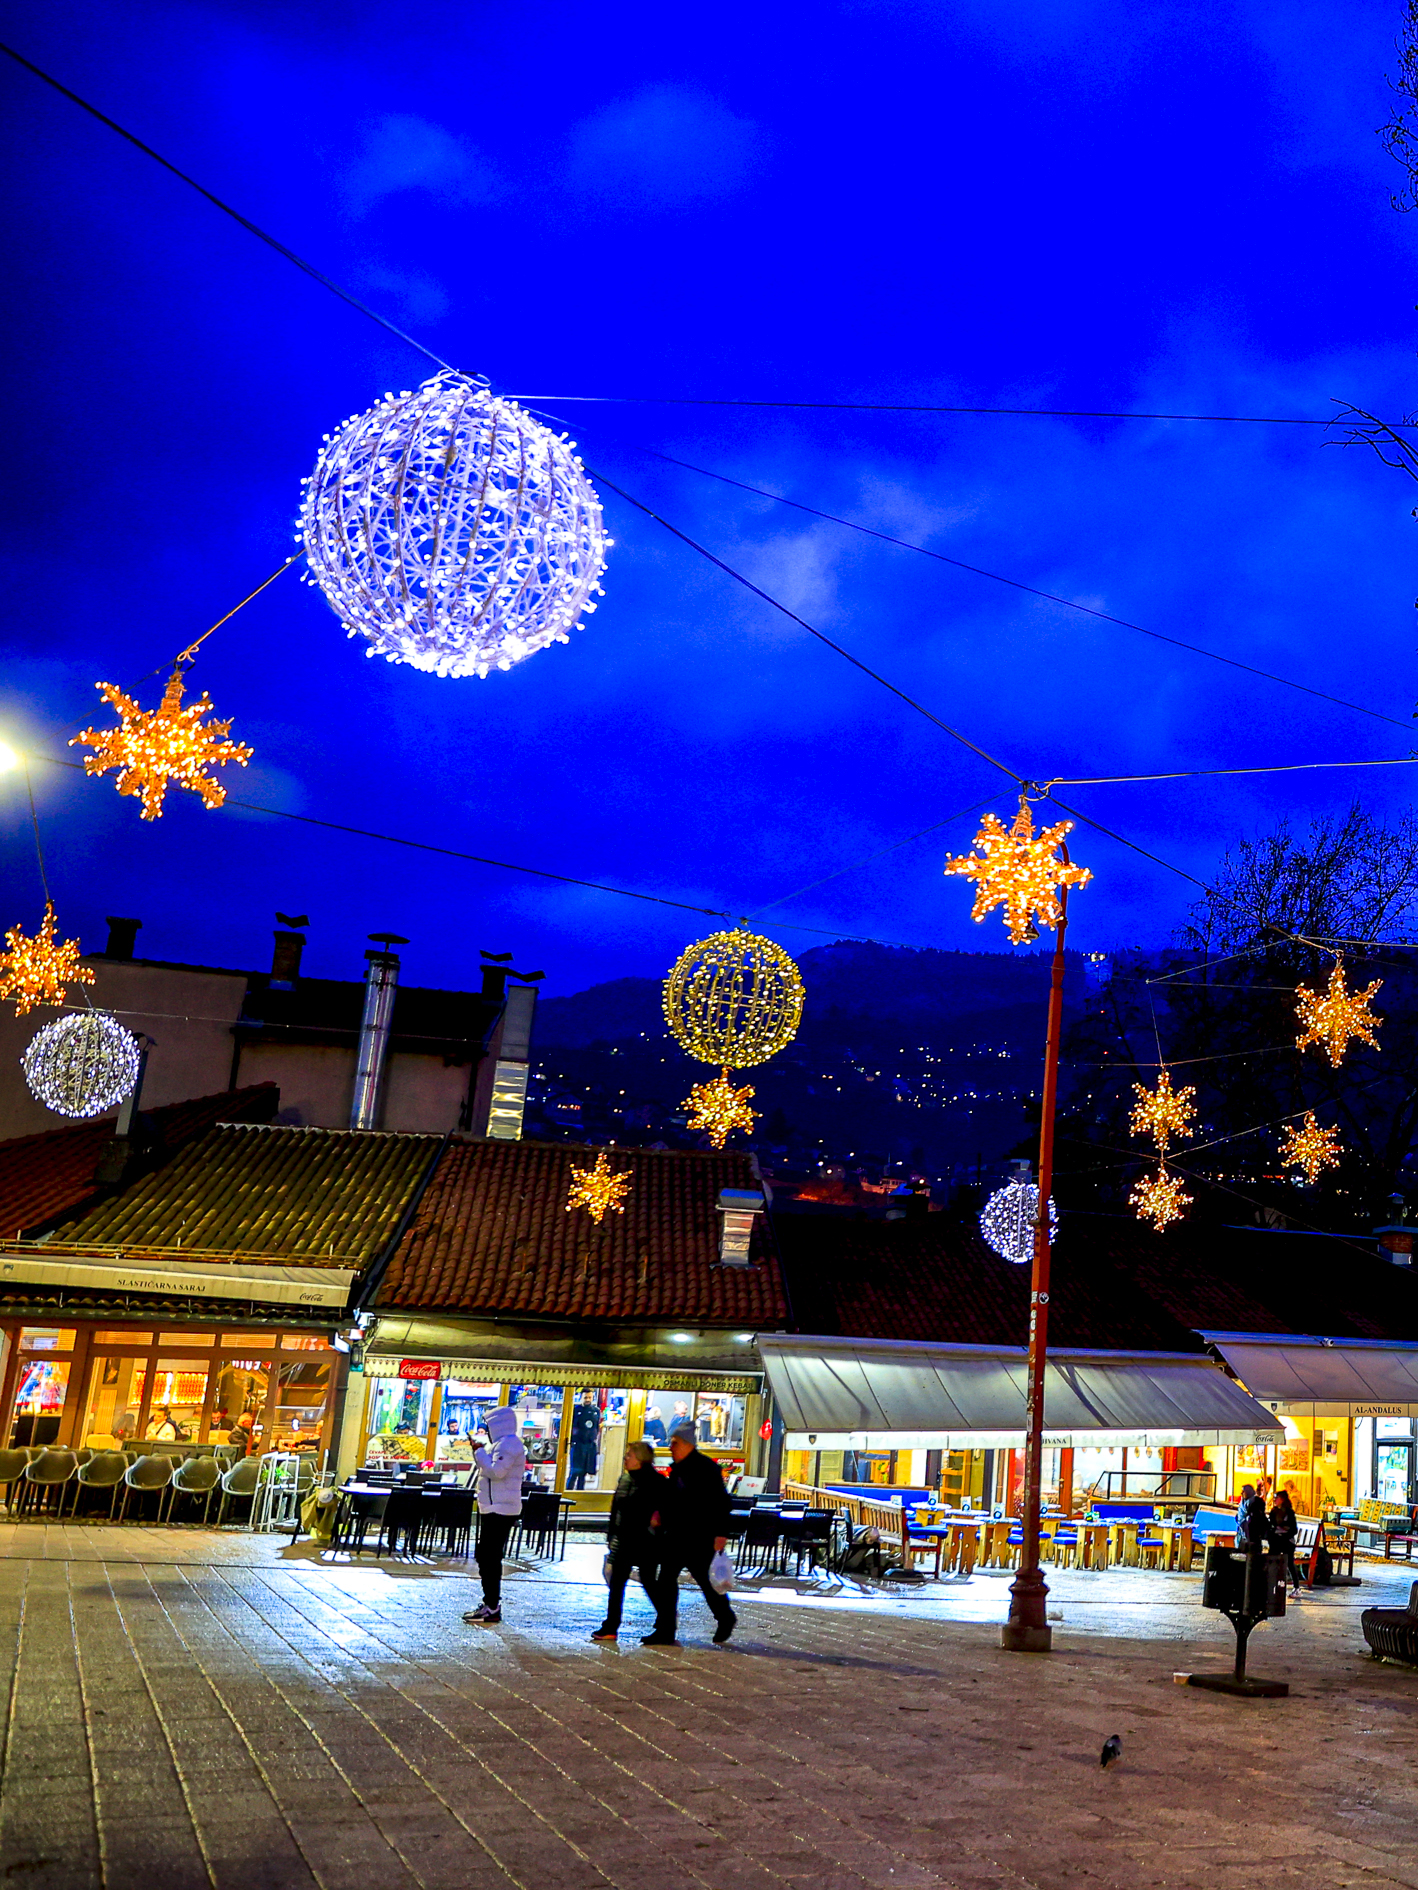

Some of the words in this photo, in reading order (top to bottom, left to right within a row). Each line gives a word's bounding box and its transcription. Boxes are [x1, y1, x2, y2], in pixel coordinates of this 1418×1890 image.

[117, 1279, 177, 1290] SLASTIČARNA
[179, 1284, 206, 1292] SARAJ
[1354, 1406, 1402, 1414] AL-ANDALUS
